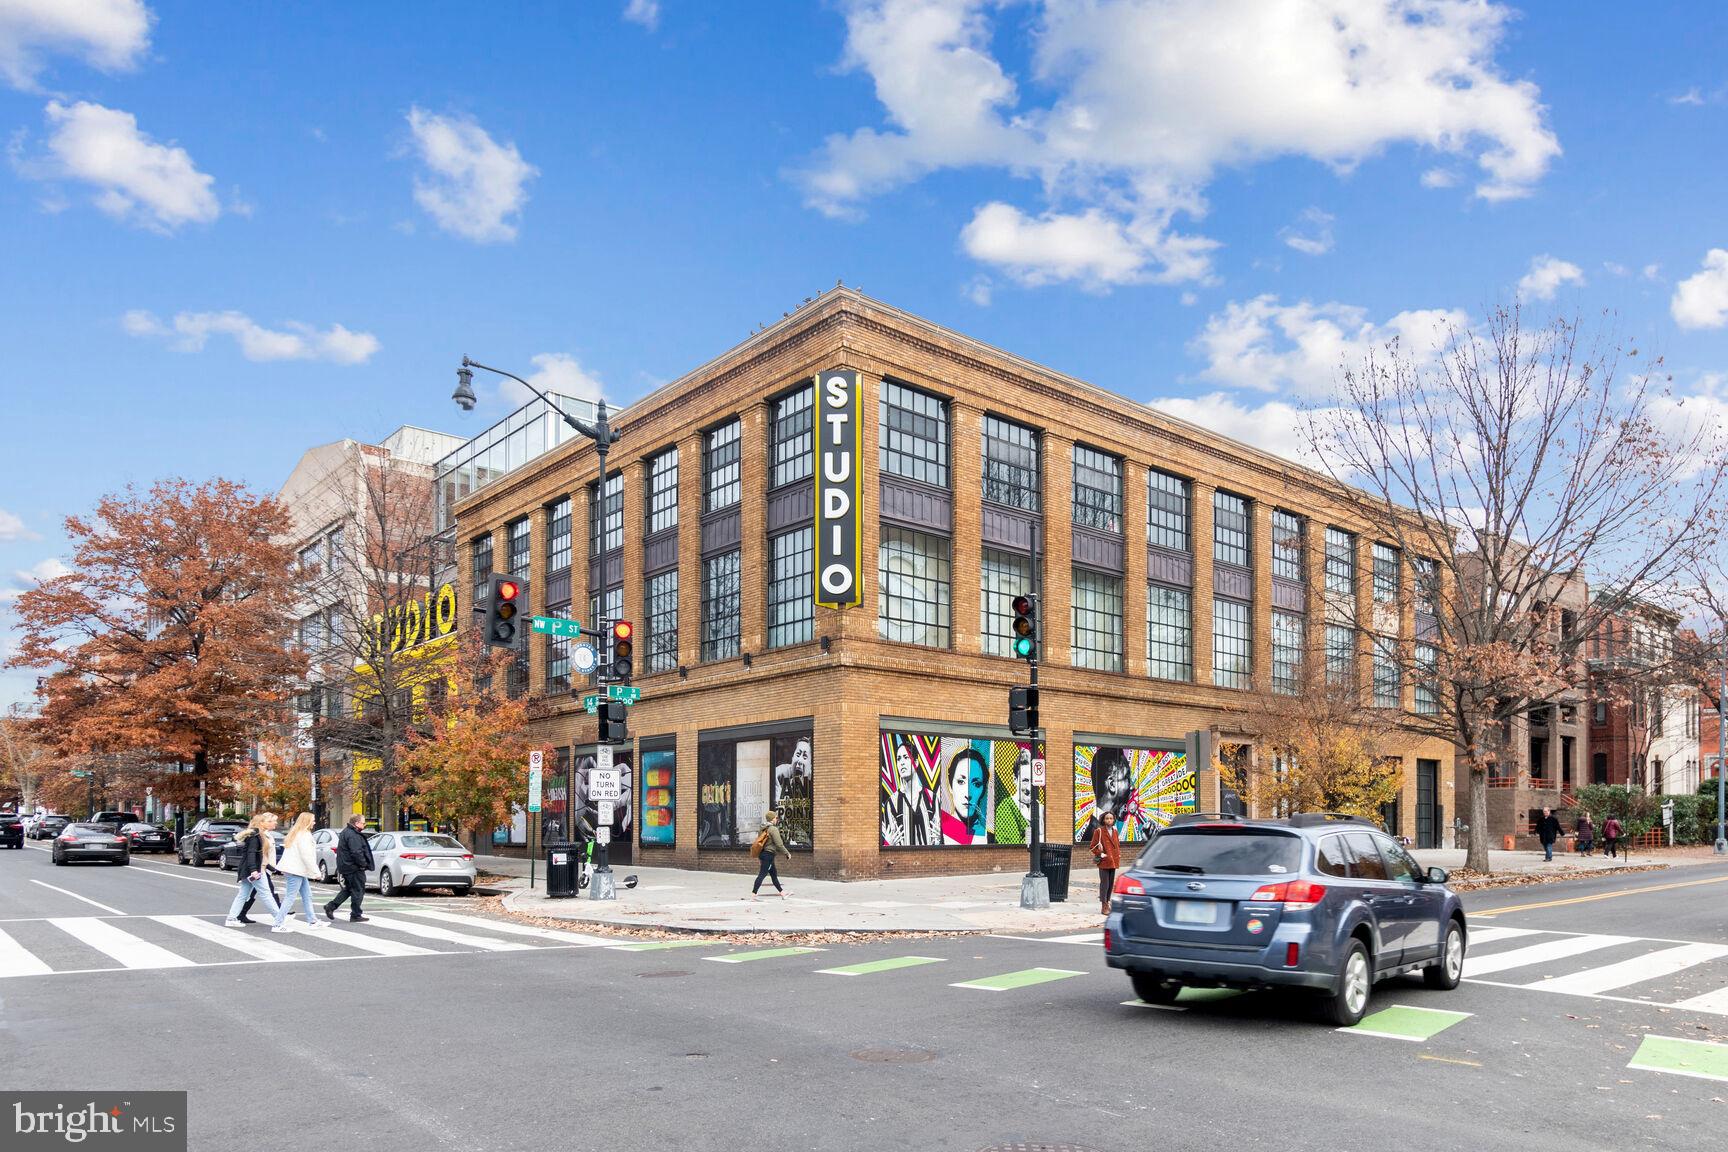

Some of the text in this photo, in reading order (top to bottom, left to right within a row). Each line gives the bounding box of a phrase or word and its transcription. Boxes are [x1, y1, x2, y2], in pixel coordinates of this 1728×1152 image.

[821, 376, 853, 595] STUDIO
[534, 619, 578, 633] NW P ST
[616, 687, 623, 695] P
[599, 772, 611, 780] NO
